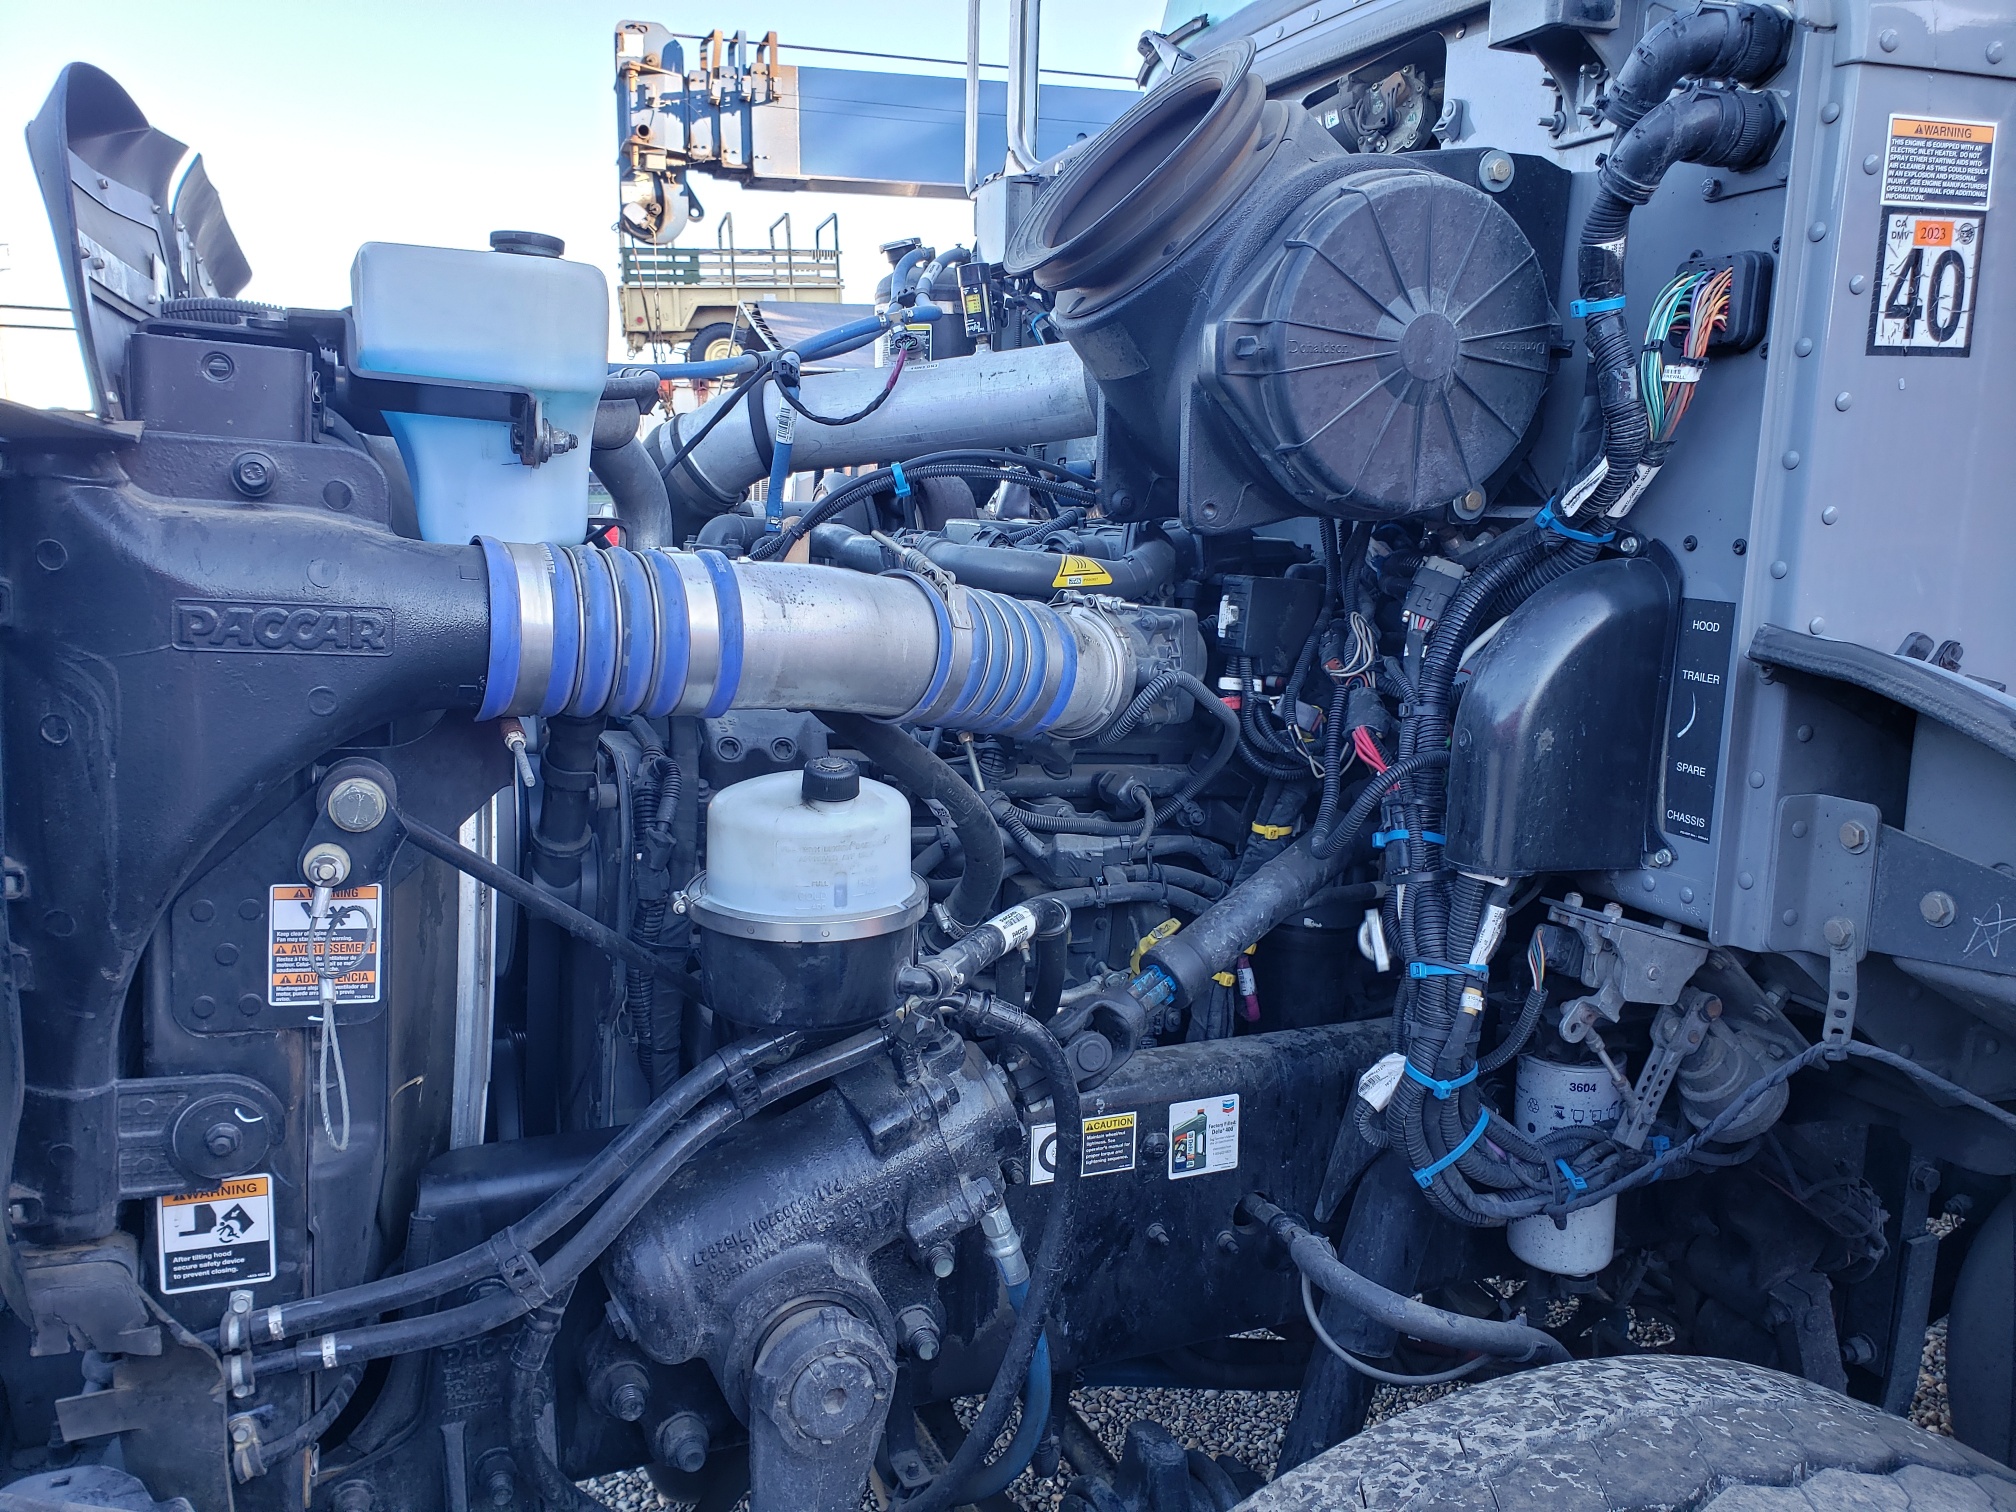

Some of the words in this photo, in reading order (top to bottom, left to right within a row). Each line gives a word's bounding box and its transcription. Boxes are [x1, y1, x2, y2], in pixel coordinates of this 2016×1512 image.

[1924, 124, 1972, 138] WARNING
[1942, 181, 1988, 190] MANUFACTURERS
[1892, 231, 1910, 240] DMV
[1895, 219, 1907, 228] CA
[1920, 227, 1946, 240] 2023
[1884, 248, 1966, 342] 40
[179, 604, 386, 650] PACCAR
[1692, 620, 1720, 632] HOOD
[1682, 670, 1720, 684] TRAILER
[1676, 762, 1706, 777] SPARE
[1667, 810, 1705, 828] CHASSIS
[308, 888, 358, 898] WNING
[295, 973, 368, 983] ADVENCIA
[1570, 1082, 1597, 1093] 3604
[1094, 1118, 1132, 1130] CAUTION
[192, 1254, 212, 1262] tilting
[214, 1250, 232, 1258] hood
[199, 1260, 220, 1269] safety
[222, 1258, 245, 1266] device
[183, 1270, 210, 1279] prevent
[211, 1266, 238, 1275] closing.
